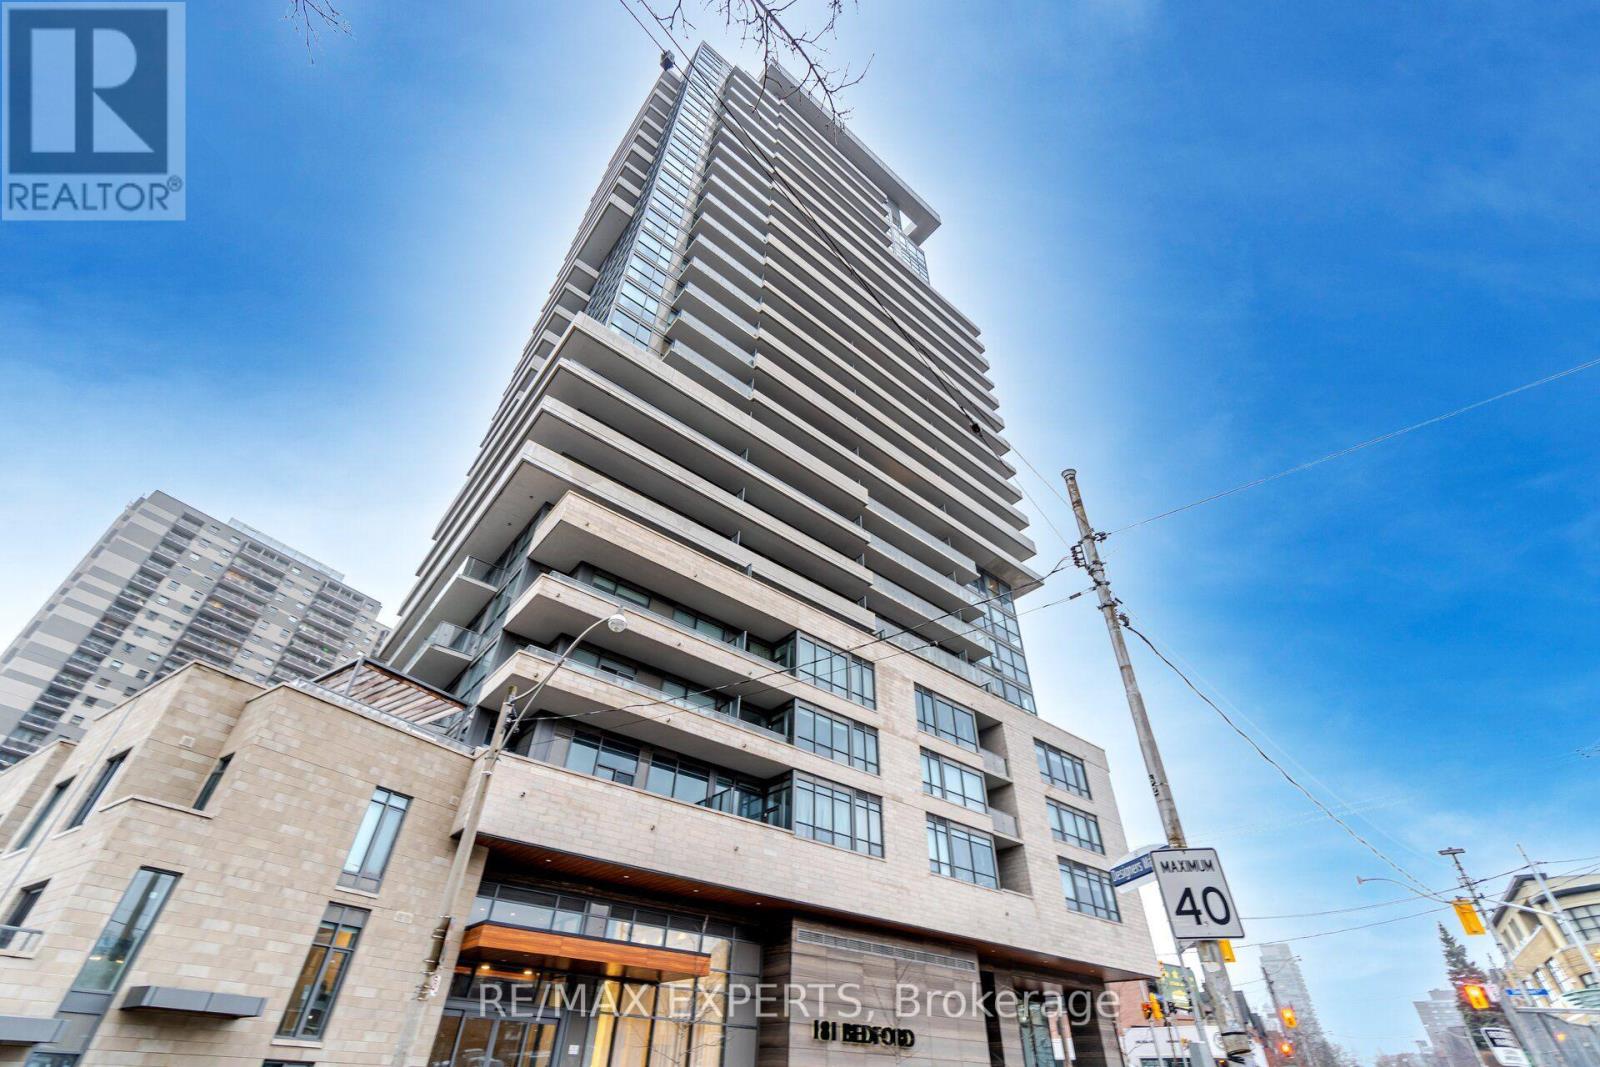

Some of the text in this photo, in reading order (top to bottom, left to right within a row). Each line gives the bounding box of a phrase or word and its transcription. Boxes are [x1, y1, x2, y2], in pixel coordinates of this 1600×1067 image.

[1159, 859, 1216, 873] MAXIMUM
[1175, 886, 1231, 926] 40
[813, 1019, 915, 1047] 181 BEDFORD
